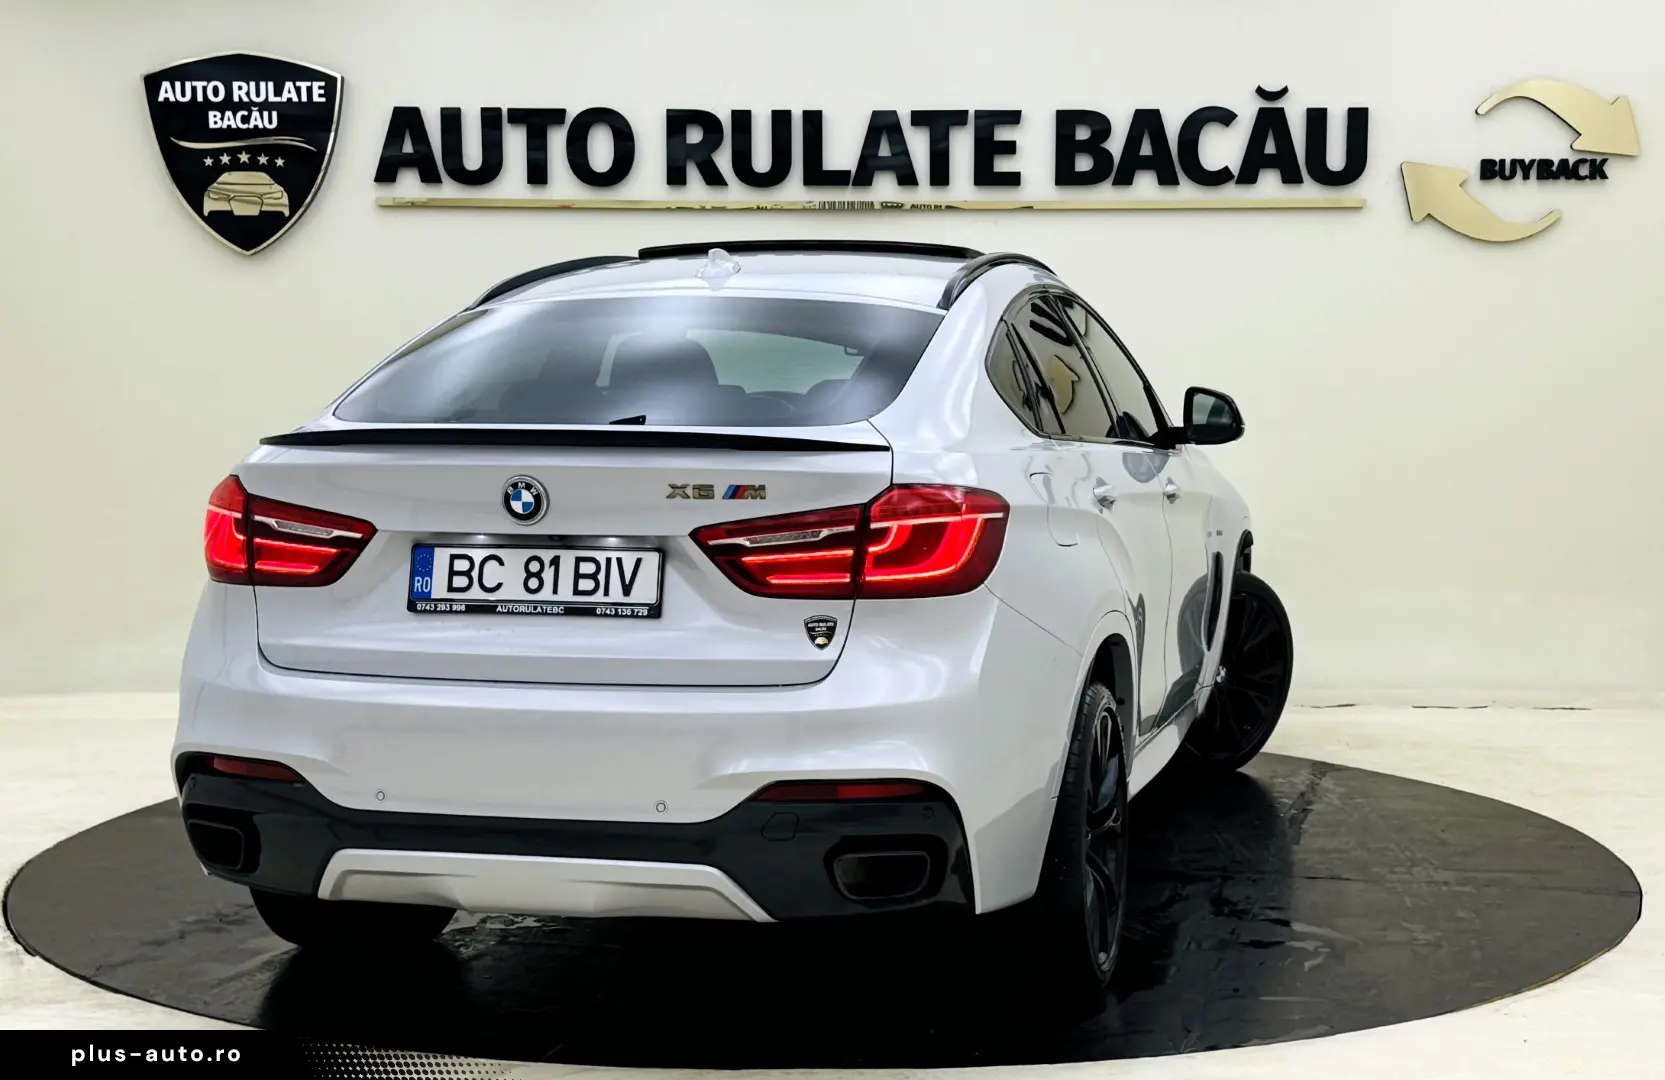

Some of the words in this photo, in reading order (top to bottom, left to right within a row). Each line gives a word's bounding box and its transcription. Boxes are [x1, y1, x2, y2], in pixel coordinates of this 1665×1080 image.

[157, 80, 226, 103] AUTO
[232, 80, 327, 103] RULATE
[208, 106, 278, 129] BACĂU
[373, 106, 636, 188] AUTO
[666, 108, 1022, 188] RULATE
[1055, 84, 1369, 187] BACĂU
[1479, 157, 1610, 182] BUYBACK
[506, 481, 539, 496] BMW
[665, 483, 715, 500] X6
[447, 553, 505, 594] BC
[523, 555, 561, 595] 81
[572, 556, 643, 597] BIV
[414, 576, 431, 592] RO
[416, 603, 435, 611] 0743
[496, 604, 565, 614] AUTORULATEBC
[596, 607, 616, 615] 0743
